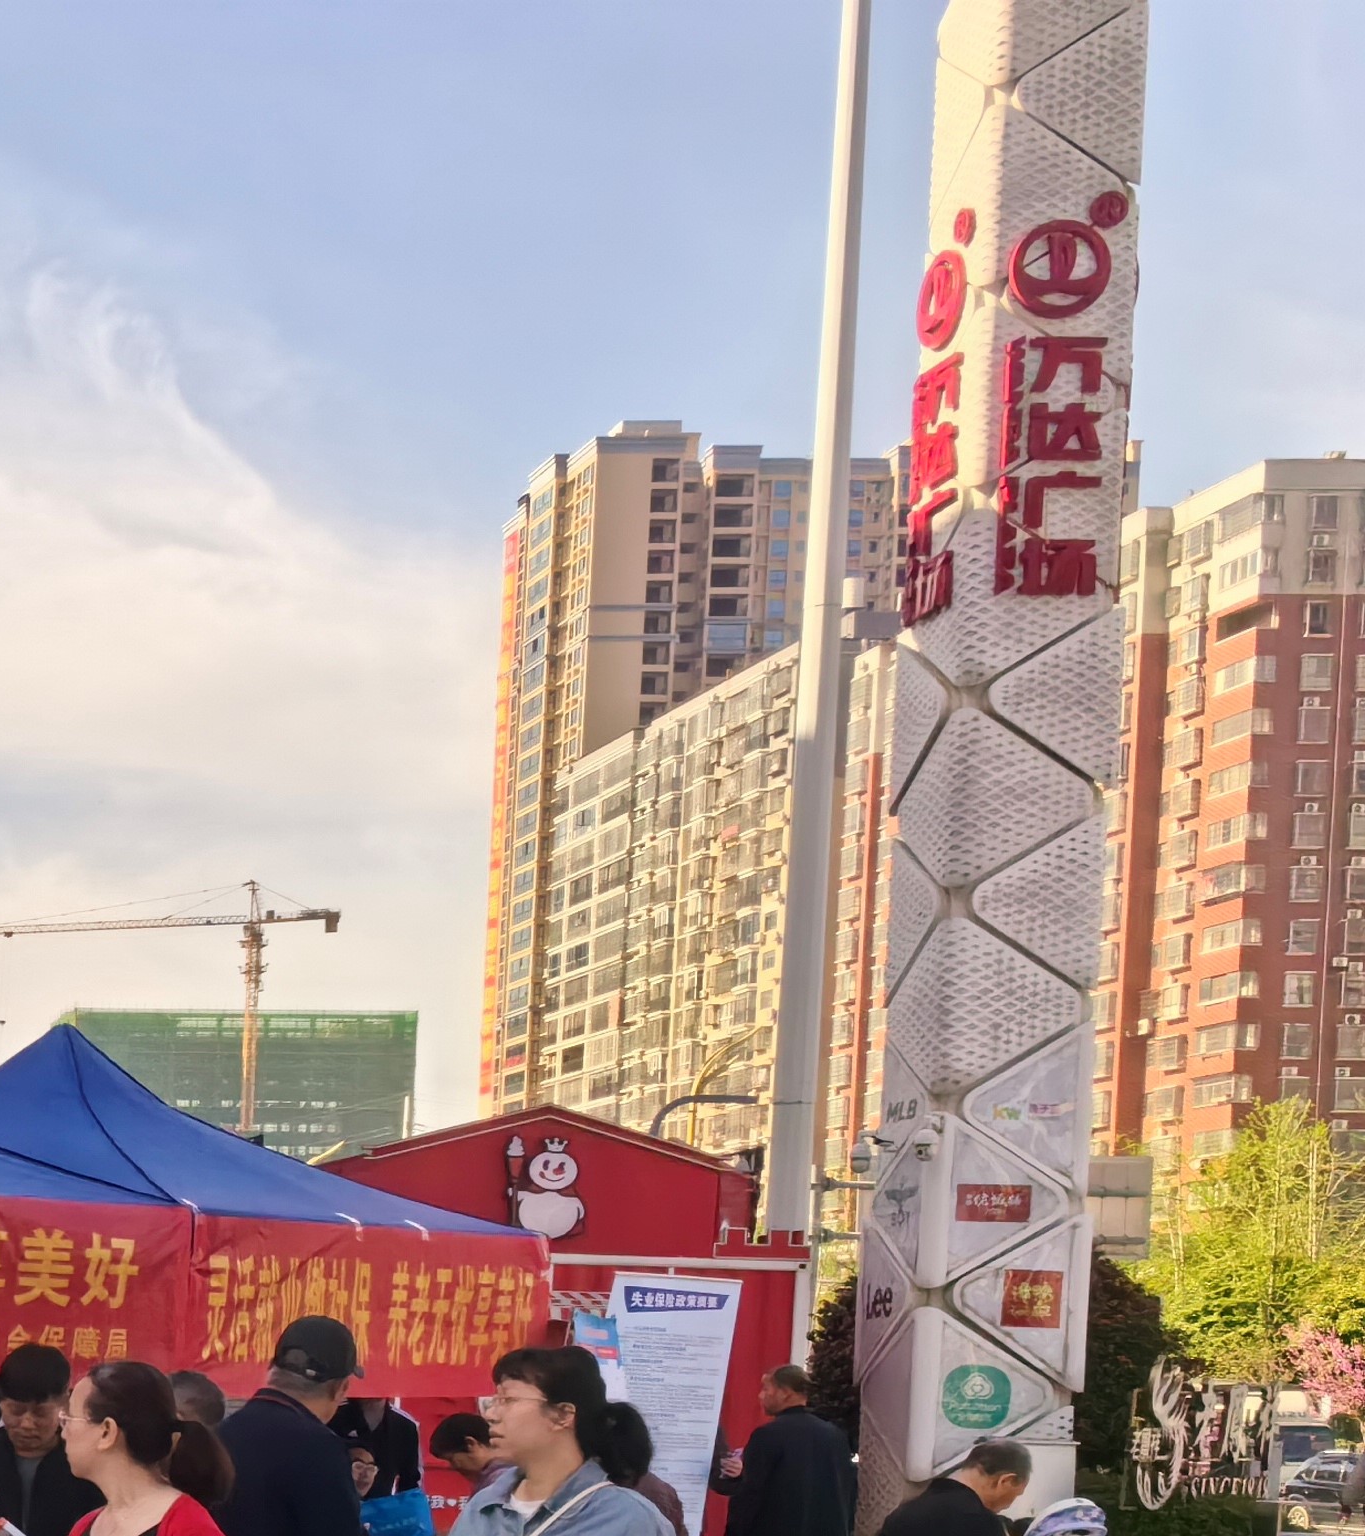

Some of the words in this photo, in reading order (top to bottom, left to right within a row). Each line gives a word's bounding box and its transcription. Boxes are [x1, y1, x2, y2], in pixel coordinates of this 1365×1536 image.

[1016, 335, 1109, 598] 万达广场
[885, 1099, 918, 1123] MLB
[866, 1281, 894, 1320] Lee
